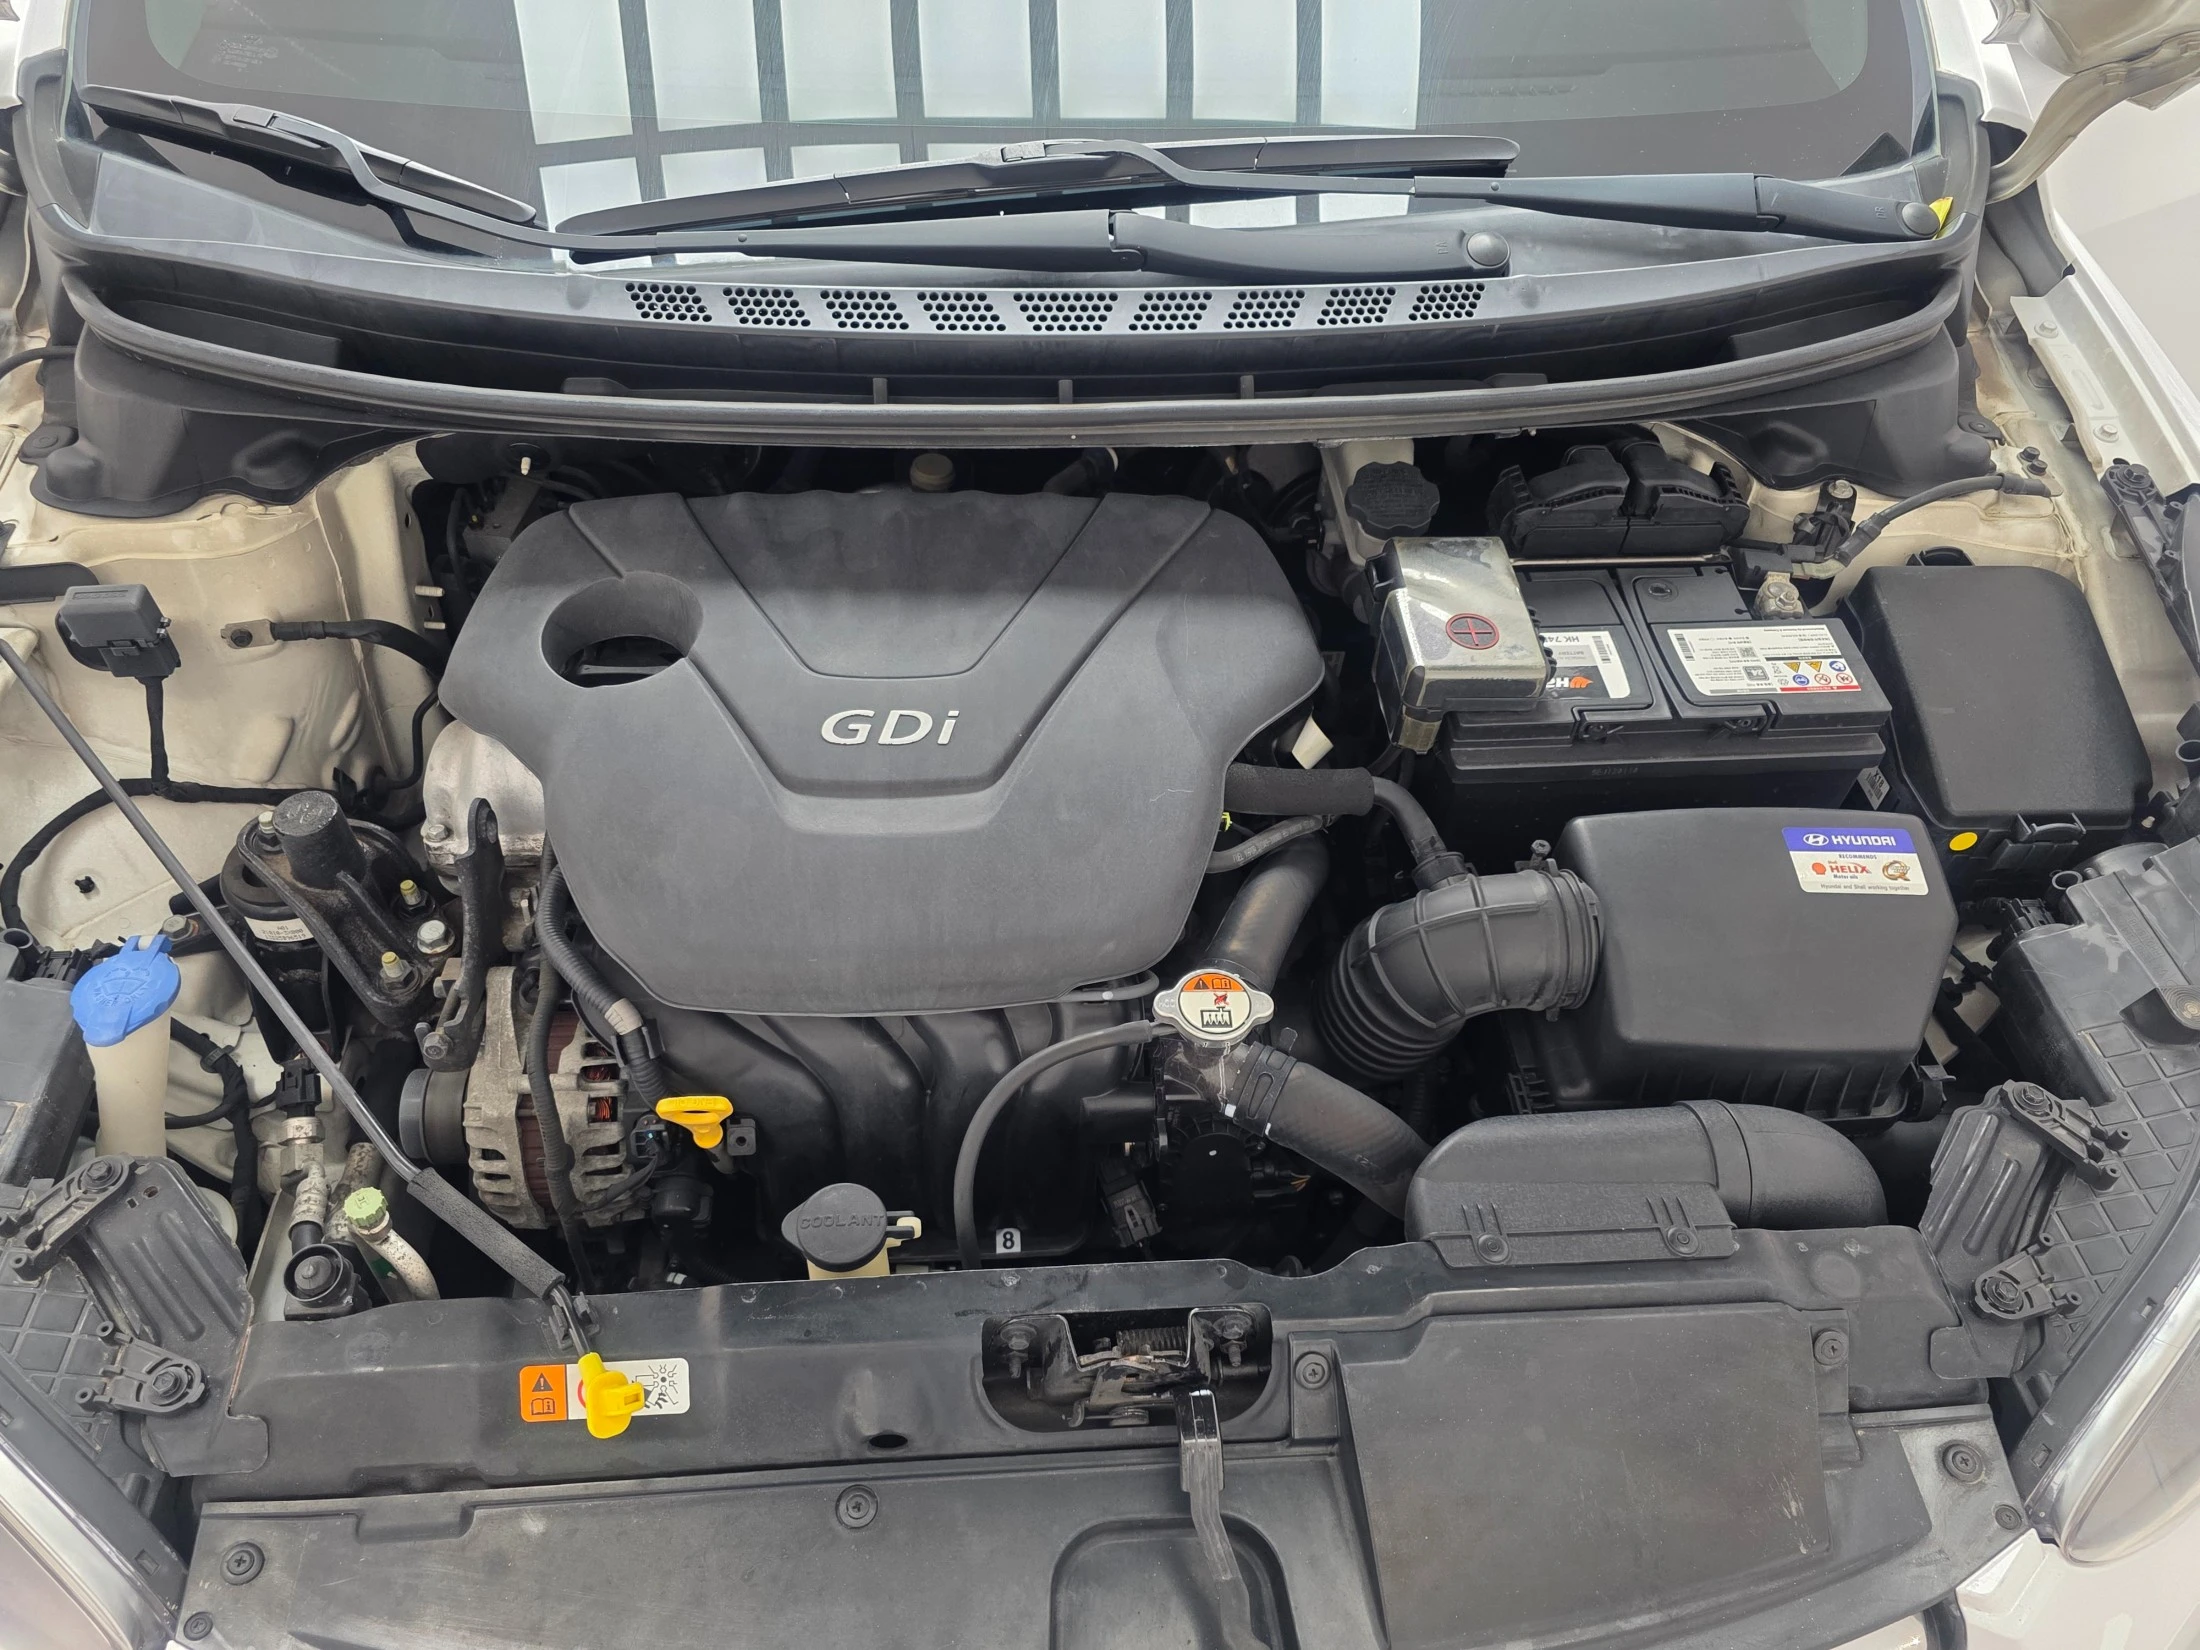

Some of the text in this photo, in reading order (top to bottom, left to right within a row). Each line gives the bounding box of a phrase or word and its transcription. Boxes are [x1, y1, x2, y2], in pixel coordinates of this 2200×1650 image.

[820, 709, 960, 745] GDi
[1831, 835, 1897, 846] HYUNDAI
[1829, 864, 1872, 874] HELIX
[1821, 883, 1843, 891] Hyundai
[799, 1213, 886, 1230] COOLANT
[1002, 1231, 1016, 1250] 8
